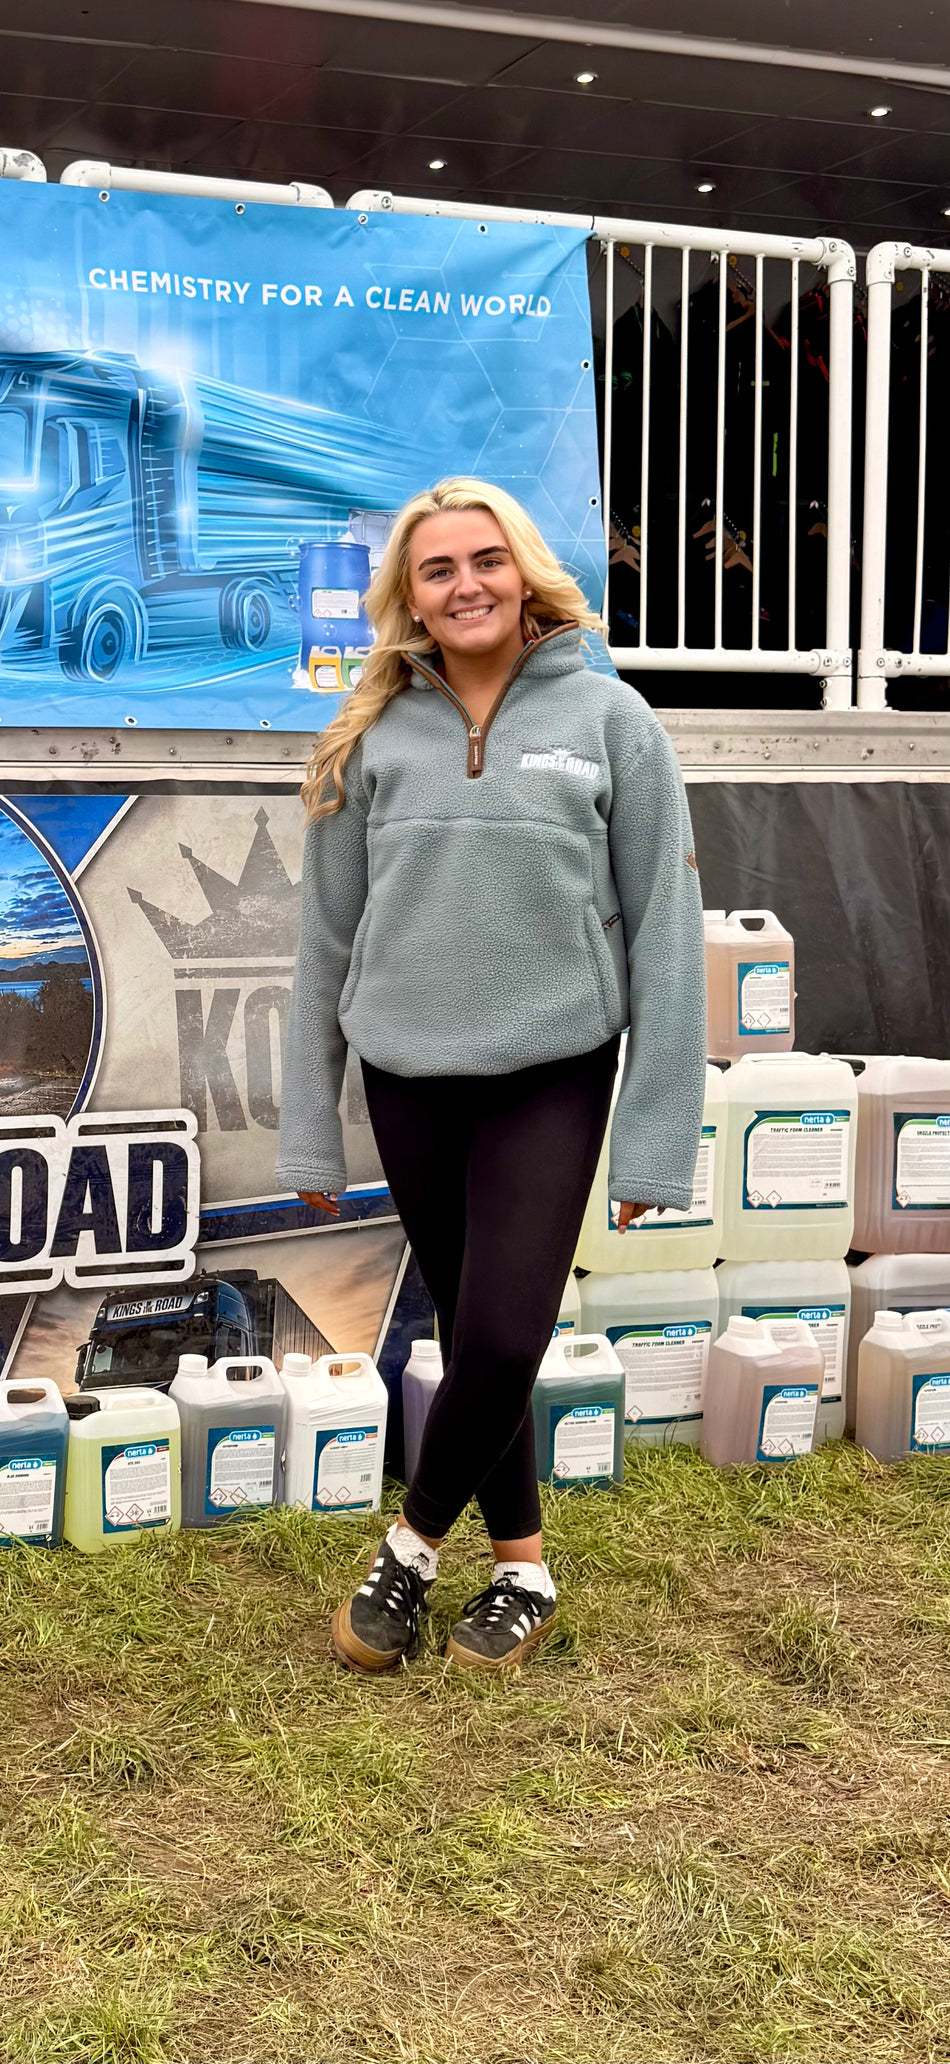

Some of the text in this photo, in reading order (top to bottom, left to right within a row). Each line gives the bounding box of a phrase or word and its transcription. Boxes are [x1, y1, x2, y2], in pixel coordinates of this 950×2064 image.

[88, 267, 552, 317] CHEMISTRY FOR A CLEAN WORLD
[520, 753, 556, 769] KINGS
[565, 756, 599, 779] ROAD
[804, 1116, 824, 1124] nerta
[112, 1302, 142, 1319] KINGS
[154, 1296, 184, 1312] ROAD
[801, 1311, 821, 1319] nerta
[666, 1328, 686, 1337] nerta
[574, 1409, 593, 1417] nerta
[339, 1434, 357, 1442] nerta
[128, 1448, 147, 1457] nerta
[12, 1461, 32, 1469] nerta
